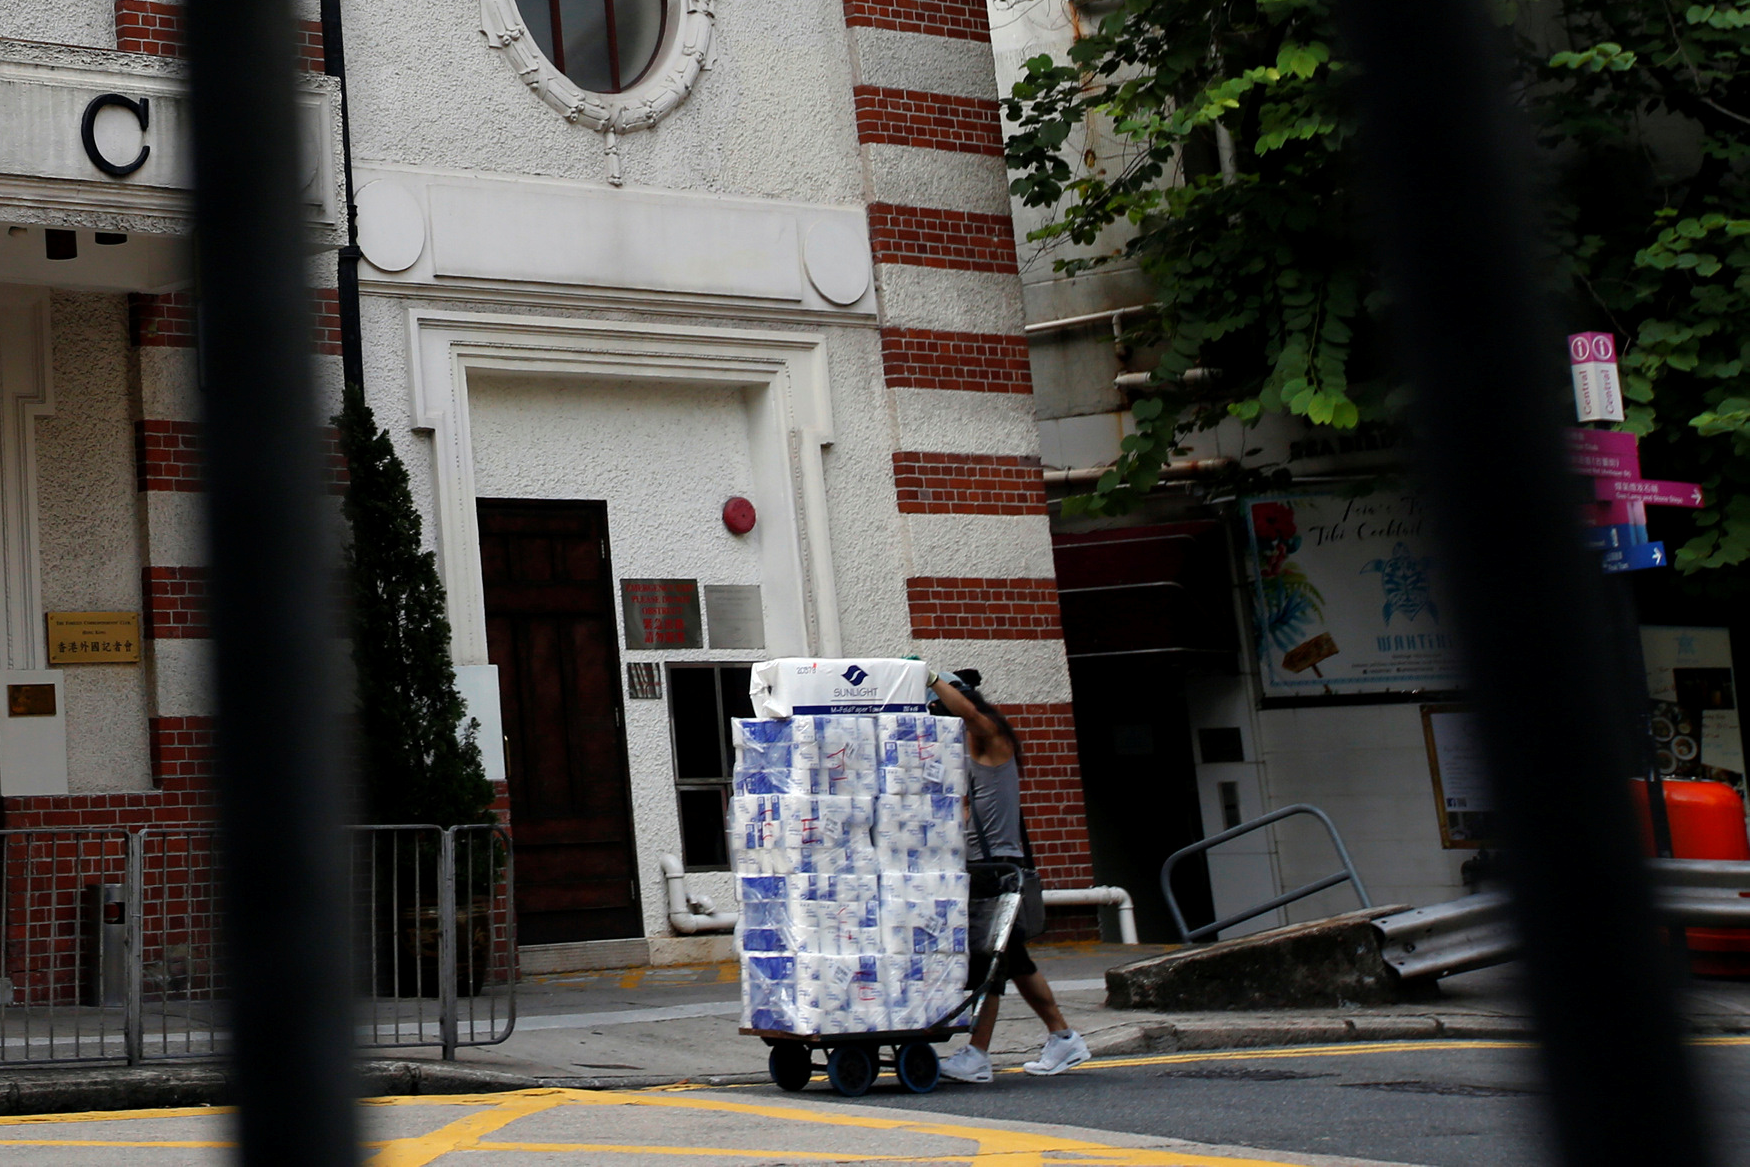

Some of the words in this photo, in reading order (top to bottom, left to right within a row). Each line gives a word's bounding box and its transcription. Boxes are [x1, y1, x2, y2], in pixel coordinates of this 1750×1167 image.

[1578, 369, 1592, 416] Central
[1600, 369, 1615, 415] Central
[631, 595, 660, 604] PLEASE
[642, 607, 683, 615] OBSTRUCT
[57, 640, 133, 653] 香港外國記者會
[833, 687, 878, 698] SUNLIGHT
